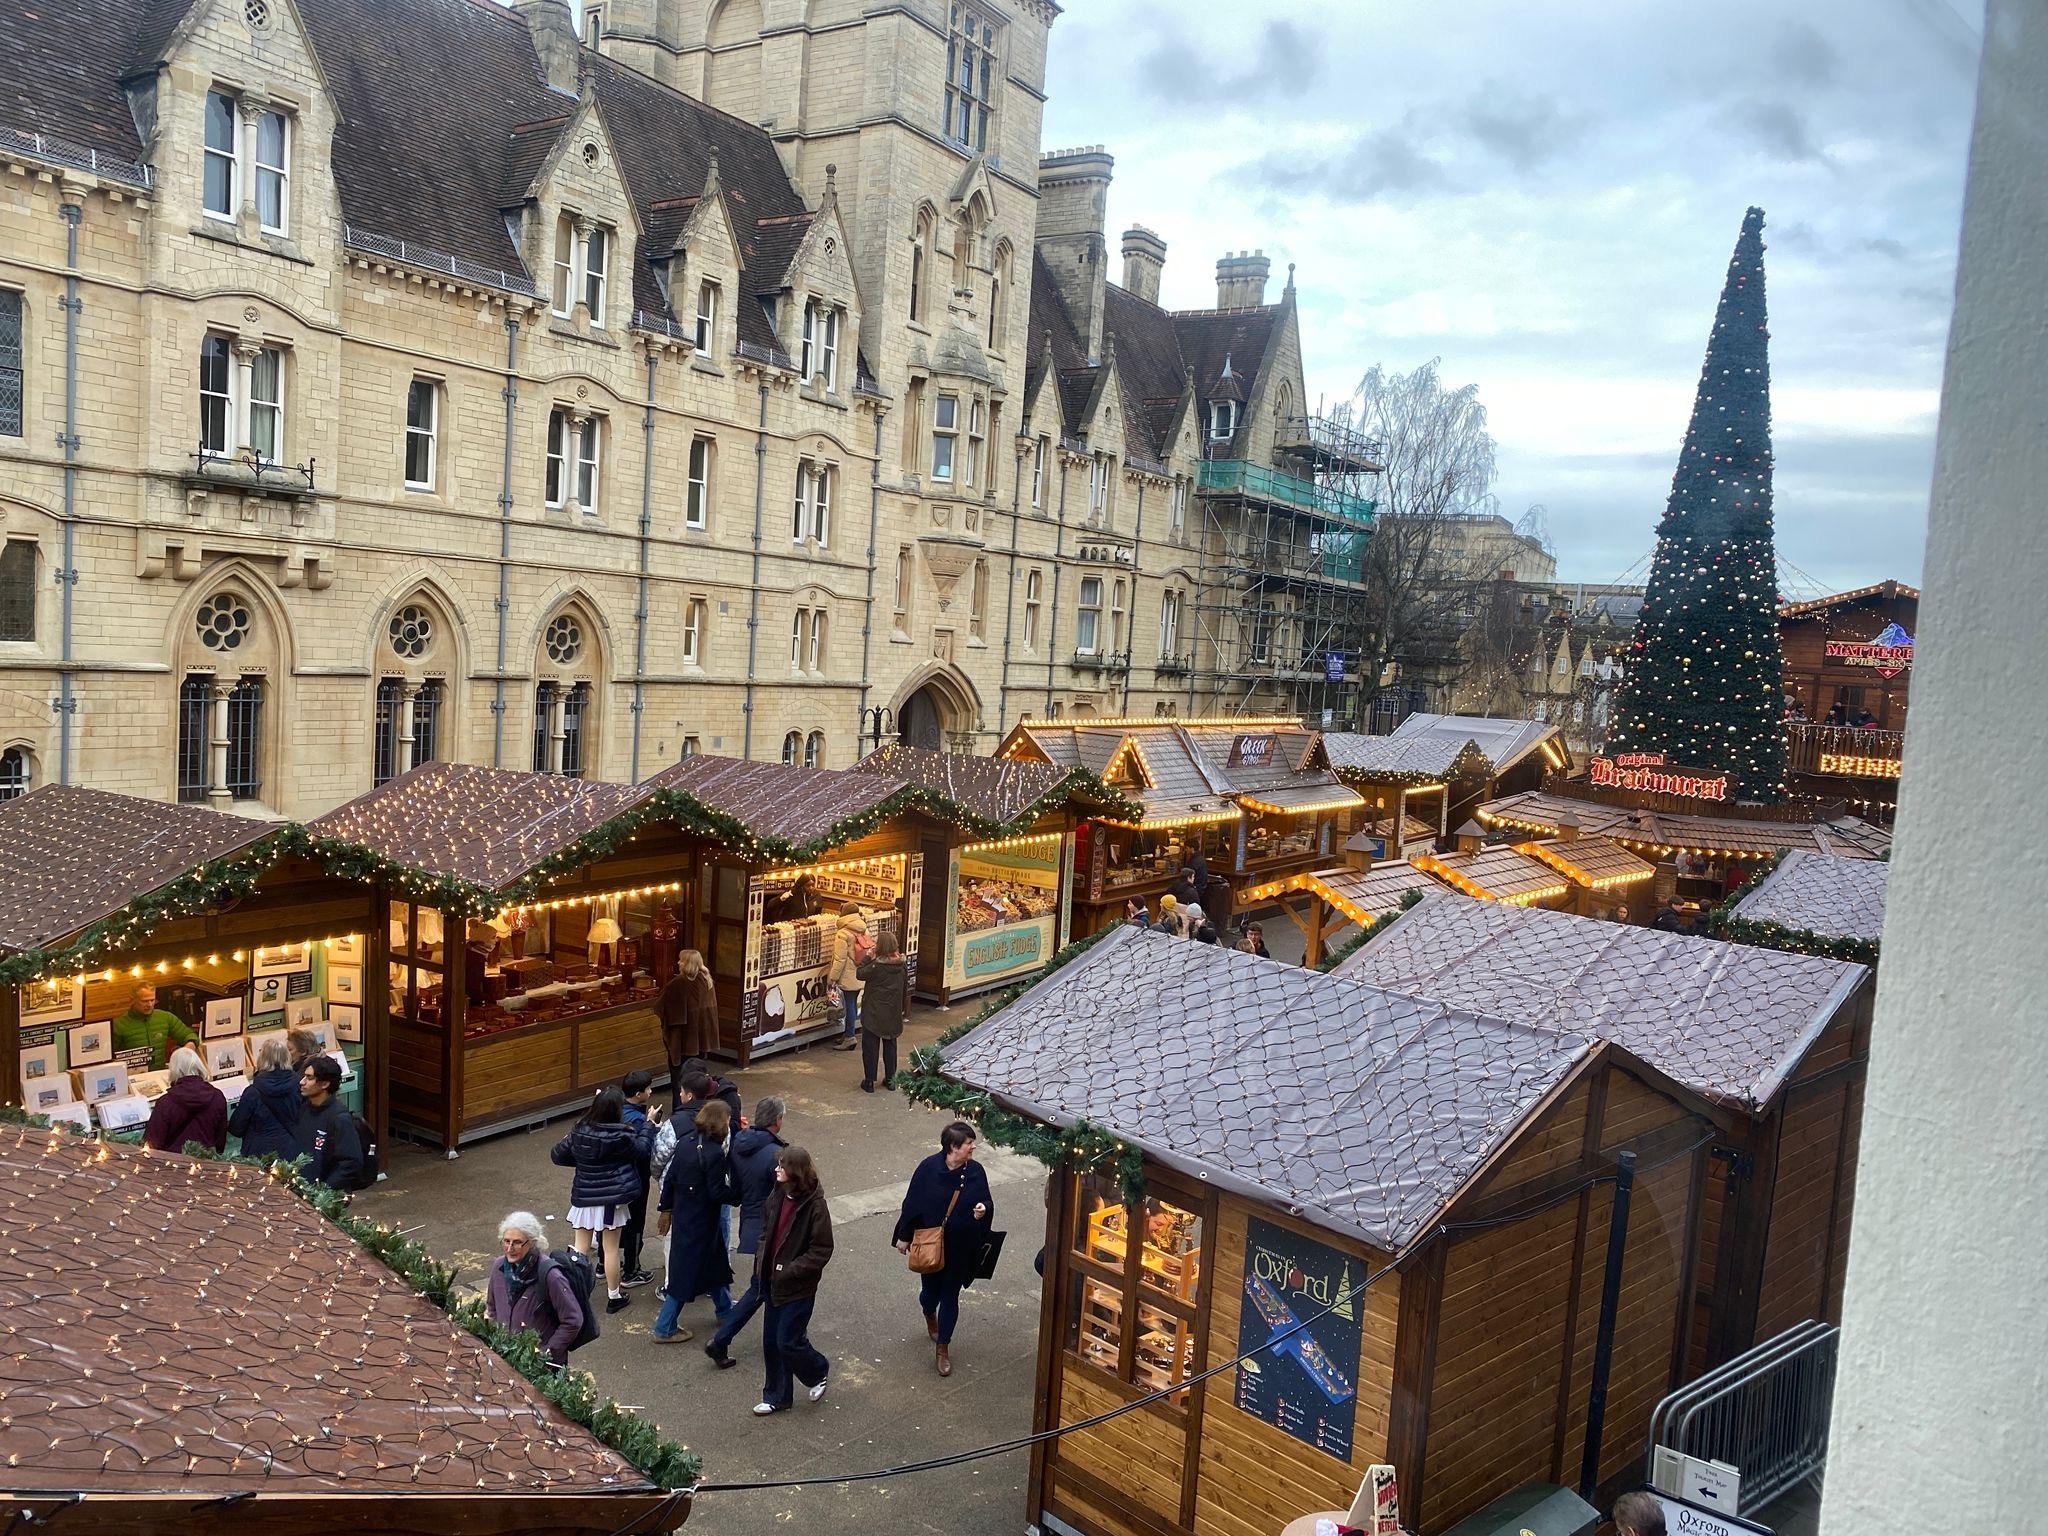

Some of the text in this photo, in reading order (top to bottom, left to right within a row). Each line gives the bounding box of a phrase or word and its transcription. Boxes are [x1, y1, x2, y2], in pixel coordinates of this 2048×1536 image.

[1241, 736, 1267, 755] GREEK
[1617, 753, 1664, 767] Original
[1590, 756, 1728, 801] Bratwurst
[967, 940, 1008, 969] ENGLISH
[1010, 935, 1038, 958] FUDGE
